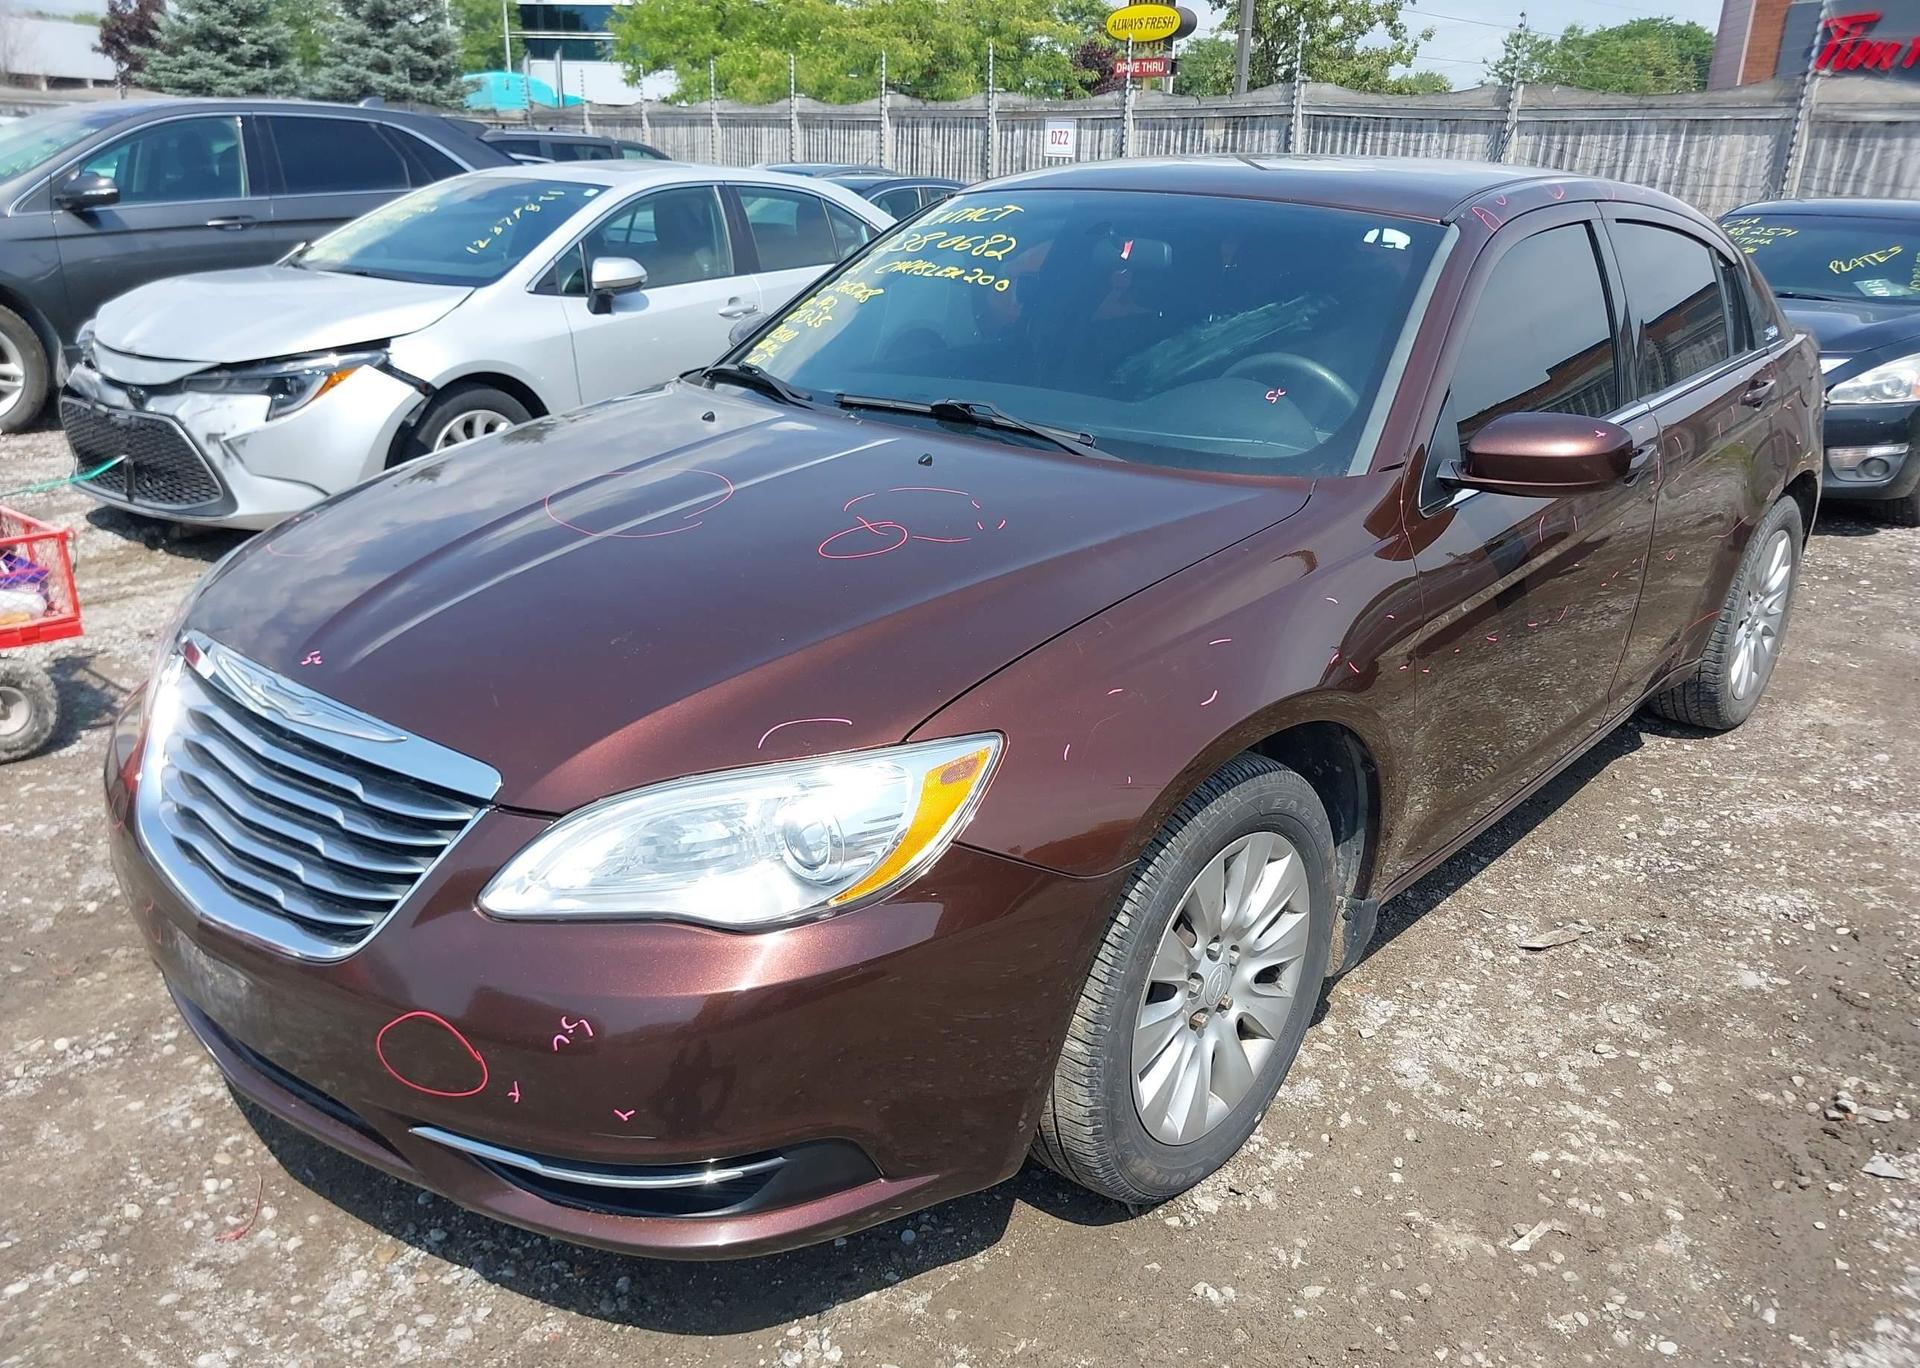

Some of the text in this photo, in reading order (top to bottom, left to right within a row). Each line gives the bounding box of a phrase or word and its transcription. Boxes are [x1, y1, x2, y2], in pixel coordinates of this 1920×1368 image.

[1111, 15, 1175, 31] ALWAYS FRESH
[1116, 61, 1164, 73] DRVE THRU
[1051, 130, 1069, 145] DZ2
[962, 268, 1010, 291] 200
